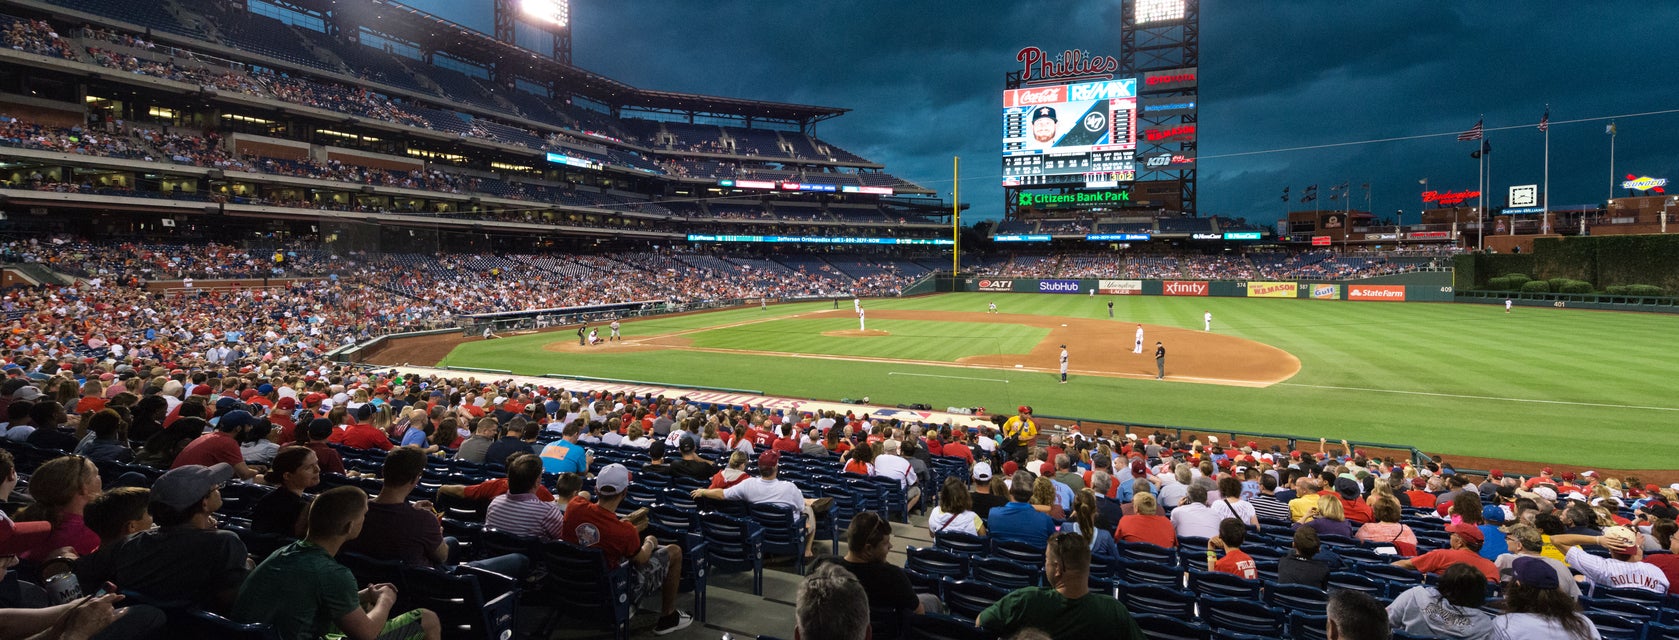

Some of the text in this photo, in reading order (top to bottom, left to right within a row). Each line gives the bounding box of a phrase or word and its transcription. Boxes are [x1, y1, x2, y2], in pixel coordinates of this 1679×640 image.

[1017, 46, 1118, 80] Phillies
[1160, 73, 1195, 83] TOYOTA
[1020, 88, 1060, 104] Coca-Cola
[1071, 81, 1134, 101] RE/MAX
[1623, 179, 1666, 188] SUNOCO
[1034, 190, 1129, 203] Citizens Bank Park
[990, 280, 1013, 288] ATI
[1040, 281, 1078, 291] StubHub
[1166, 282, 1205, 295] xfinity
[1253, 284, 1295, 295] W.B.MASON
[1314, 286, 1334, 296] Gulf
[1611, 573, 1659, 590] ROLLINS
